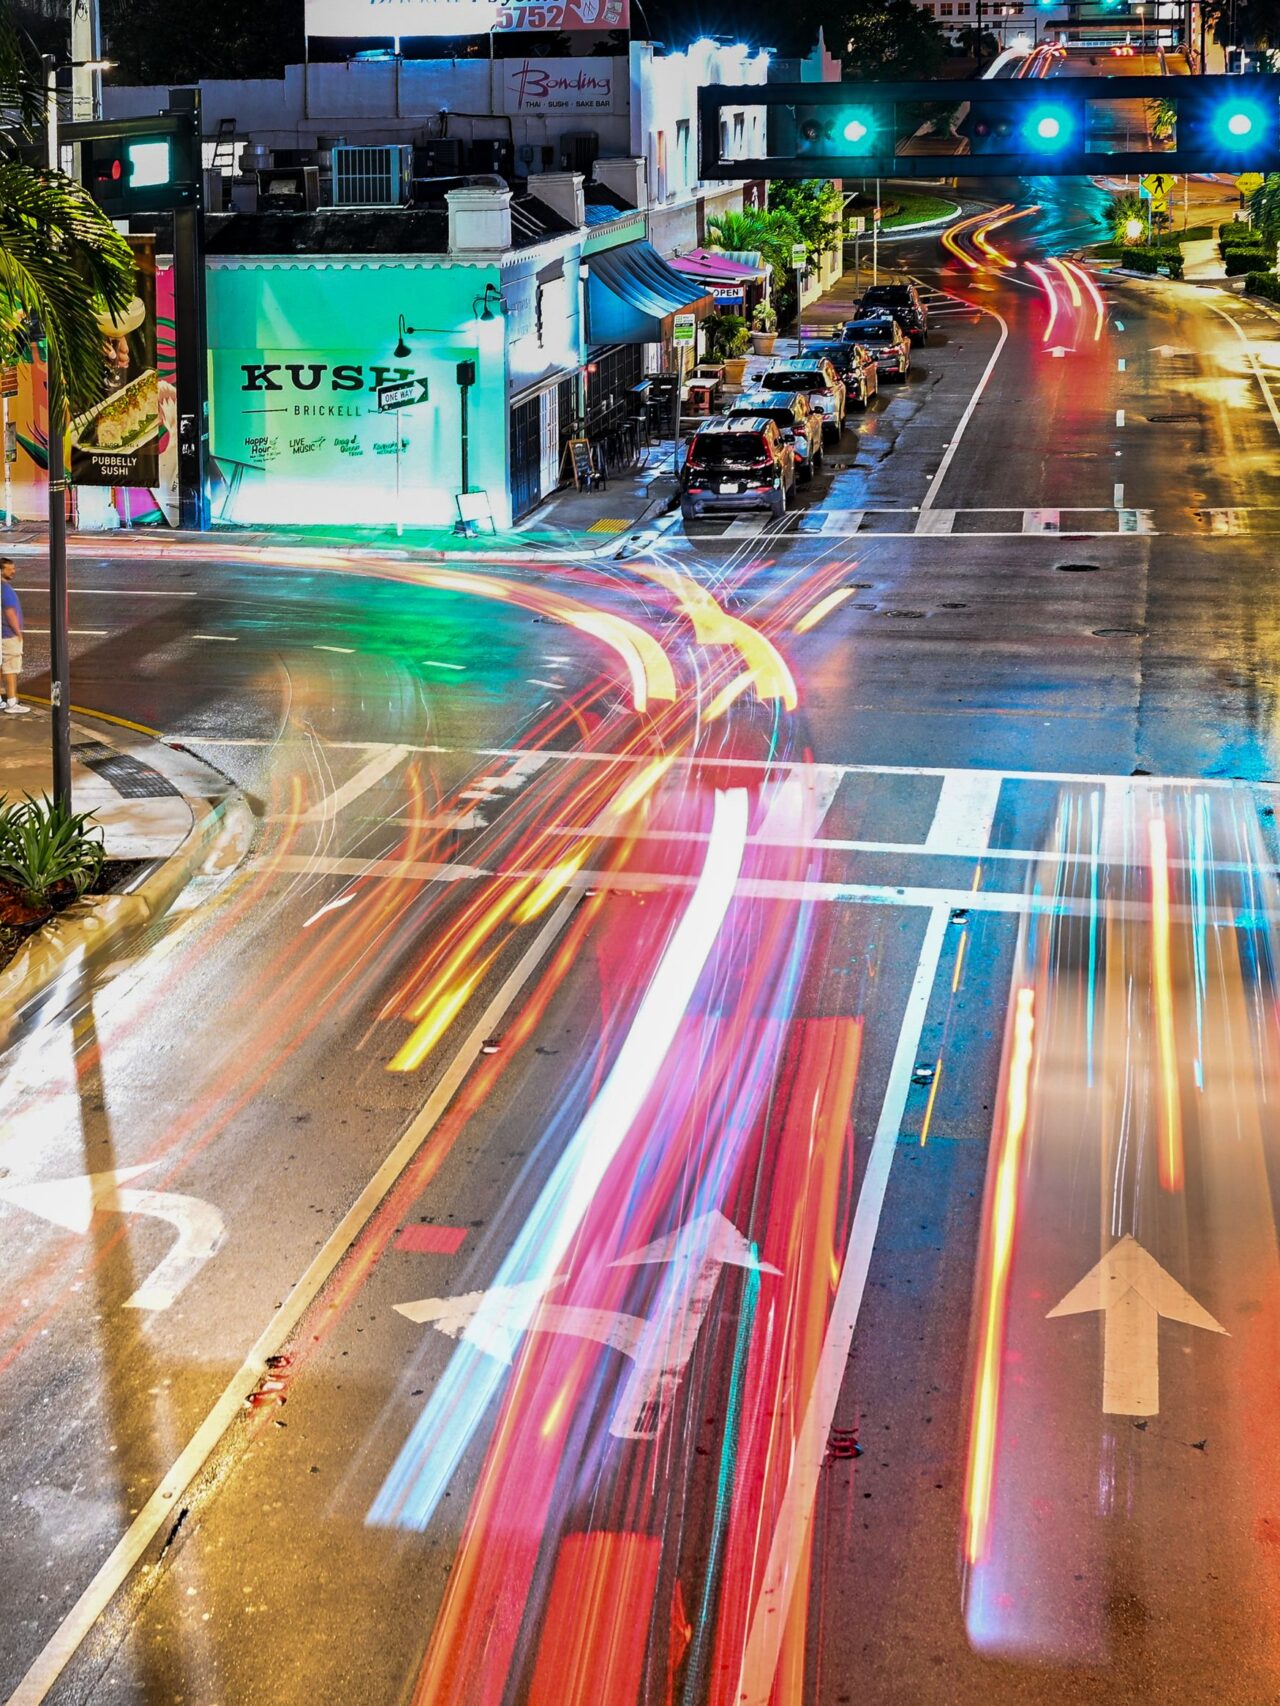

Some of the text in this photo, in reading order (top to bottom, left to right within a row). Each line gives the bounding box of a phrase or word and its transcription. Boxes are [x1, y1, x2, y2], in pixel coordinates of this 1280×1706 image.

[495, 5, 563, 29] 5752
[507, 59, 610, 109] Bonding
[713, 289, 739, 297] OPEN
[240, 364, 415, 392] KUSH
[385, 388, 414, 403] ONE WAY
[294, 405, 363, 417] BRICKELL
[244, 436, 268, 446] Happy
[289, 437, 305, 447] LIVE
[251, 445, 272, 455] Hour
[293, 443, 317, 454] MUSIC
[92, 456, 137, 466] PUBBELLY
[101, 466, 128, 475] SUSHI
